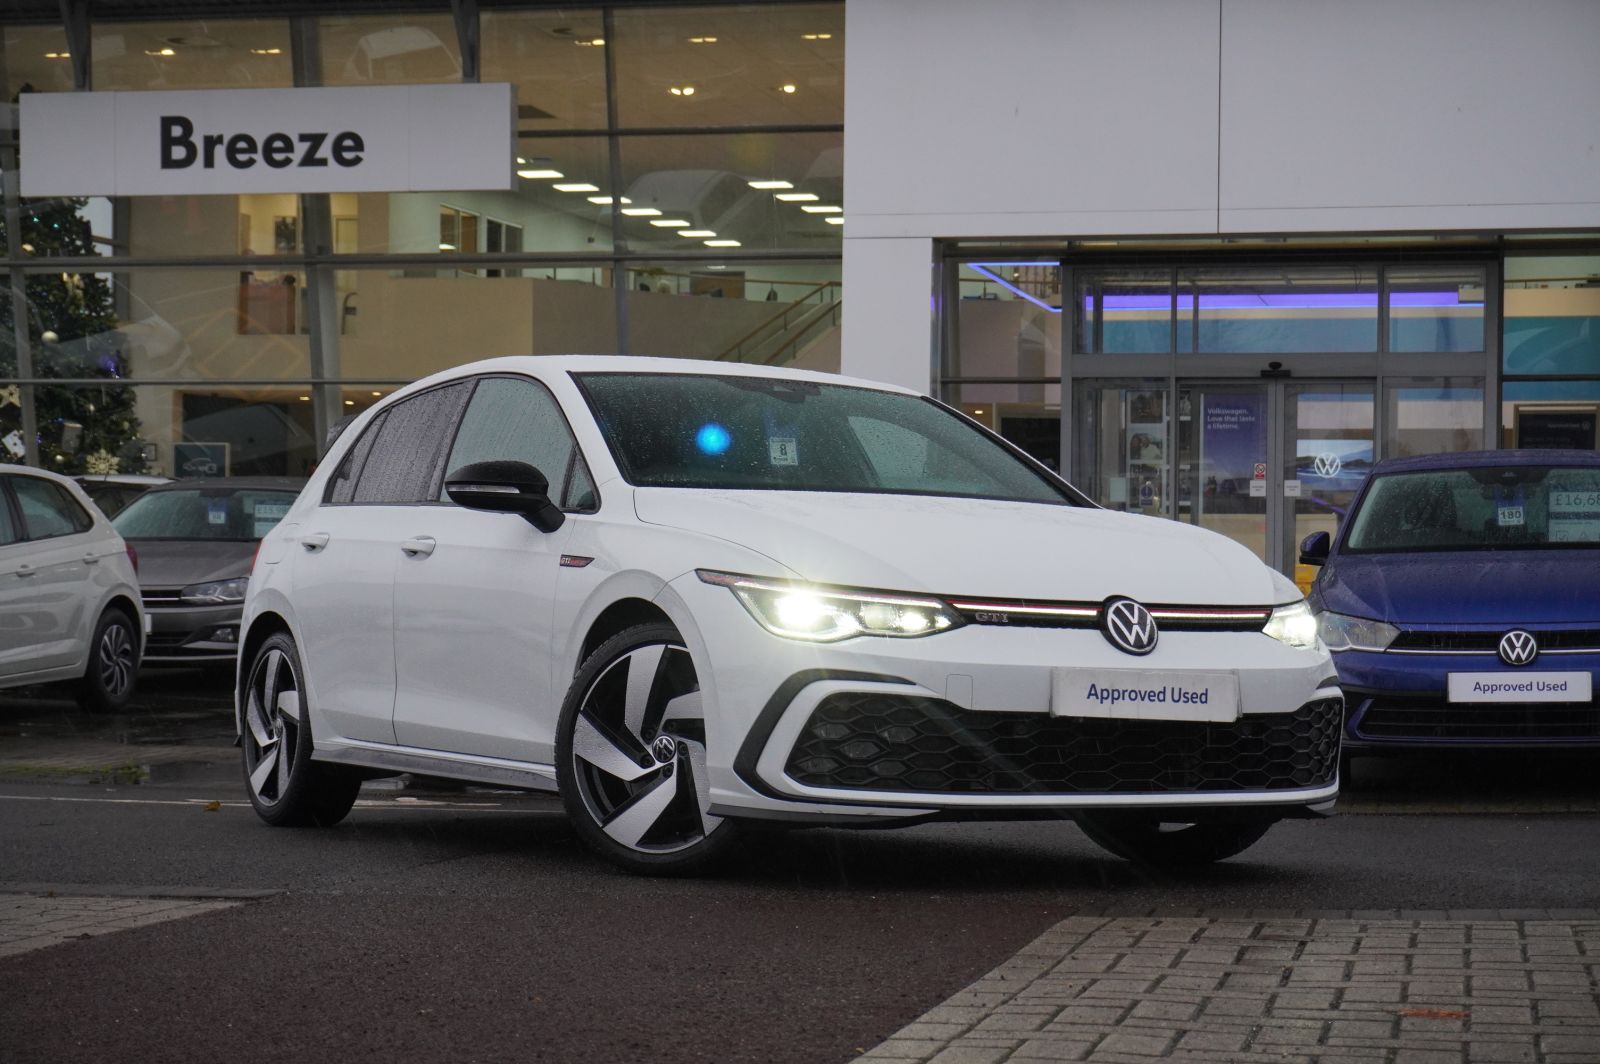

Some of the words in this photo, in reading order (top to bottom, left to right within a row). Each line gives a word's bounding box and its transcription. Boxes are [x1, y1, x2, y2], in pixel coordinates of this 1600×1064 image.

[160, 115, 364, 169] Breeze
[975, 612, 1009, 623] GTI
[1087, 683, 1167, 705] Approved
[1171, 687, 1208, 704] Used
[1473, 681, 1533, 694] Approved
[1536, 681, 1567, 692] Used
